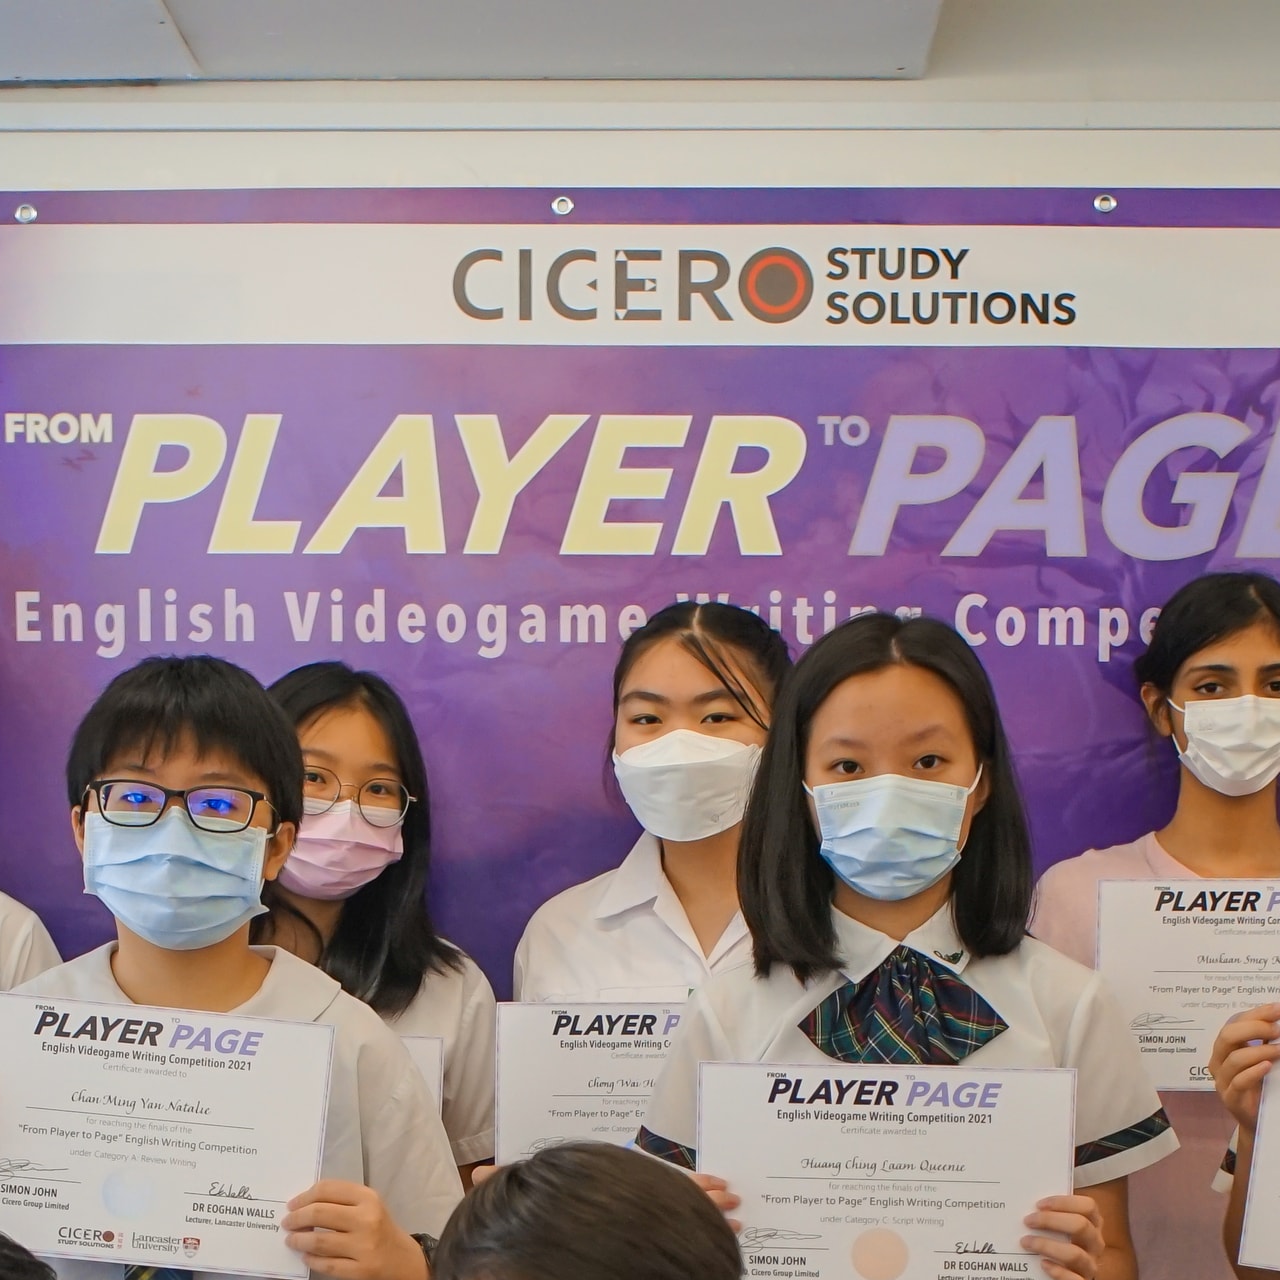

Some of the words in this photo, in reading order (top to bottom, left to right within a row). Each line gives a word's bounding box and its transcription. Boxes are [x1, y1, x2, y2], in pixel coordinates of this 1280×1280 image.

[826, 248, 969, 281] STUDY
[452, 247, 814, 324] CICERO
[826, 292, 1076, 326] SOLUTIONS
[5, 413, 112, 443] FROM
[95, 414, 807, 556] PLAYER
[818, 416, 869, 446] TO
[15, 589, 256, 658] English
[284, 589, 647, 658] Videogame
[1155, 891, 1261, 912] PLAYER
[1163, 916, 1190, 926] English
[1192, 916, 1235, 926] Videogame
[1237, 917, 1265, 927] Writing
[553, 1015, 657, 1035] PLAYER
[34, 1011, 163, 1047] PLAYER
[169, 1024, 264, 1056] PAGE
[560, 1040, 587, 1050] English
[589, 1040, 632, 1050] Videogame
[634, 1040, 661, 1050] Writing
[42, 1042, 75, 1054] English
[78, 1045, 129, 1059] Videogame
[133, 1050, 166, 1065] Writing
[169, 1054, 225, 1068] Competition
[228, 1060, 251, 1071] 2021
[72, 1089, 99, 1104] Chan
[768, 1079, 899, 1105] PLAYER
[906, 1082, 1002, 1108] PAGE
[778, 1110, 811, 1122] English
[814, 1110, 866, 1123] Videogame
[870, 1112, 904, 1124] Writing
[907, 1112, 965, 1125] Competition
[968, 1114, 991, 1123] 2021
[19, 1124, 47, 1134] "From
[50, 1127, 80, 1139] Player
[82, 1131, 92, 1139] to
[95, 1131, 123, 1143] Page"
[125, 1134, 159, 1146] English
[162, 1138, 196, 1151] Writing
[199, 1141, 257, 1155] Competition
[1, 1184, 30, 1195] SIMON
[32, 1187, 57, 1197] JOHN
[193, 1203, 204, 1212] DR
[207, 1204, 244, 1216] EOGHAN
[247, 1208, 274, 1218] WALLS
[761, 1195, 790, 1203] "From
[794, 1195, 823, 1206] Player
[826, 1197, 836, 1205] to
[839, 1196, 867, 1208] Page"
[870, 1197, 904, 1208] English
[907, 1198, 942, 1209] Writing
[945, 1199, 1005, 1210] Competition
[58, 1227, 115, 1243] CICERO
[132, 1232, 182, 1245] Lancaster
[132, 1241, 180, 1254] University
[749, 1255, 778, 1264] SIMON
[781, 1257, 806, 1265] JOHN
[944, 1261, 956, 1269] DR
[959, 1261, 996, 1271] EOGHAN
[999, 1263, 1028, 1272] WALLS
